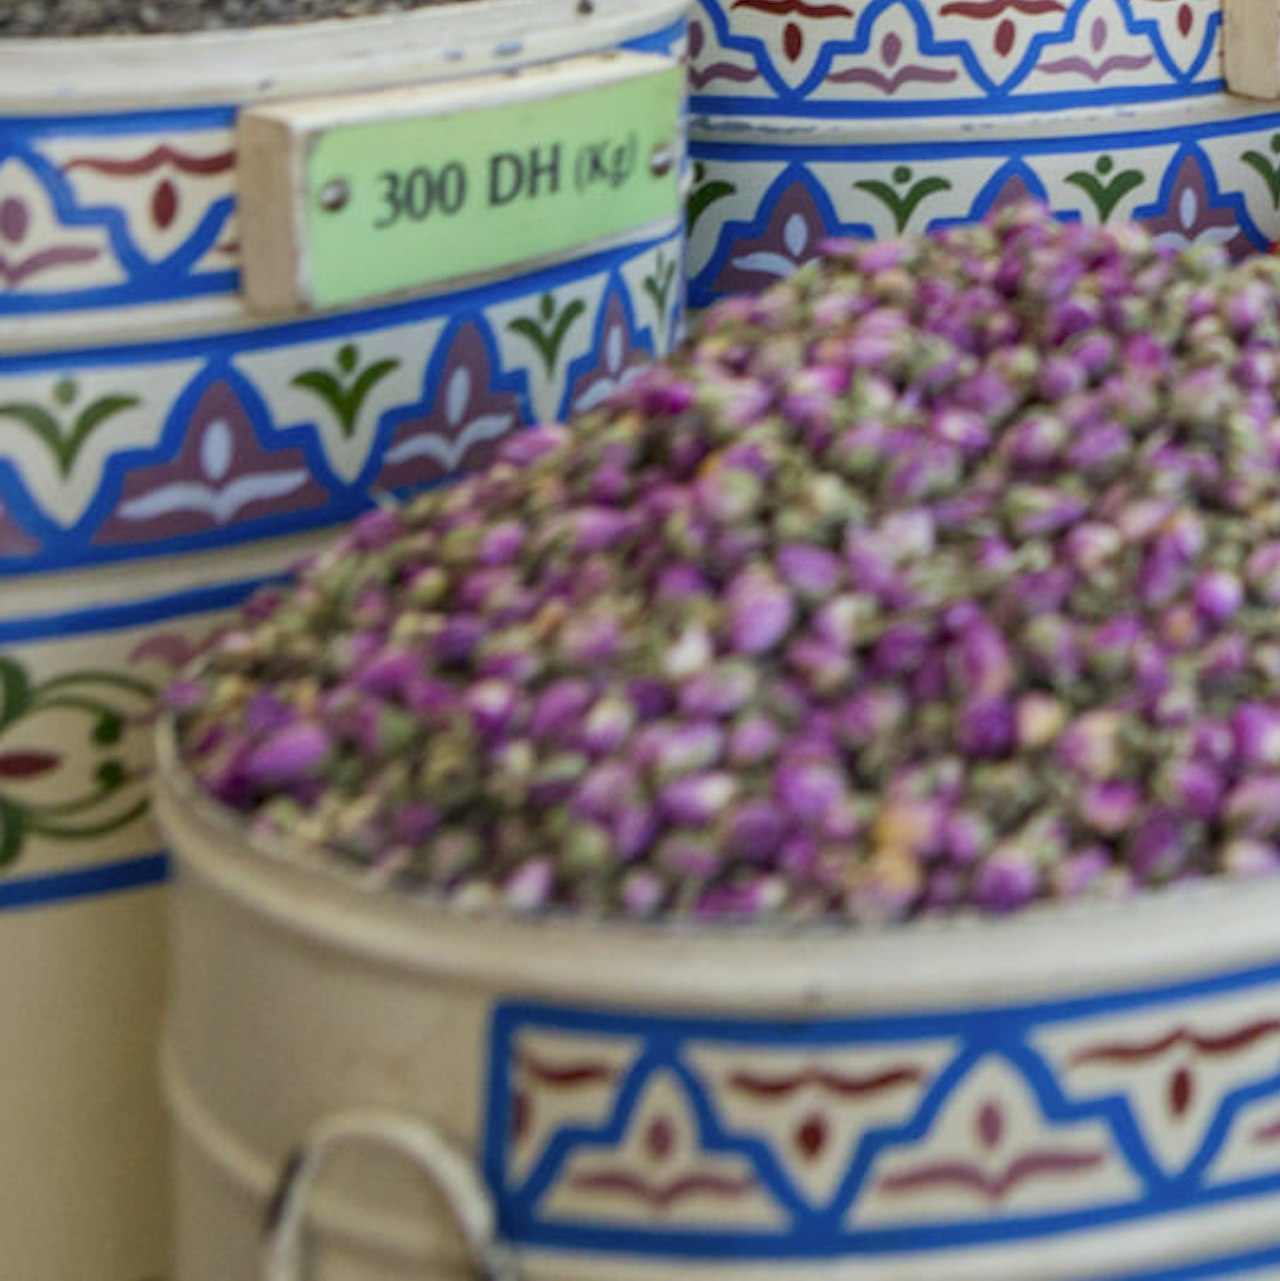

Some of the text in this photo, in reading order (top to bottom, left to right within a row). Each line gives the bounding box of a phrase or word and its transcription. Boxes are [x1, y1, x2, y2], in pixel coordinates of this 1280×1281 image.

[373, 129, 639, 230] 300 DH (Kg)
